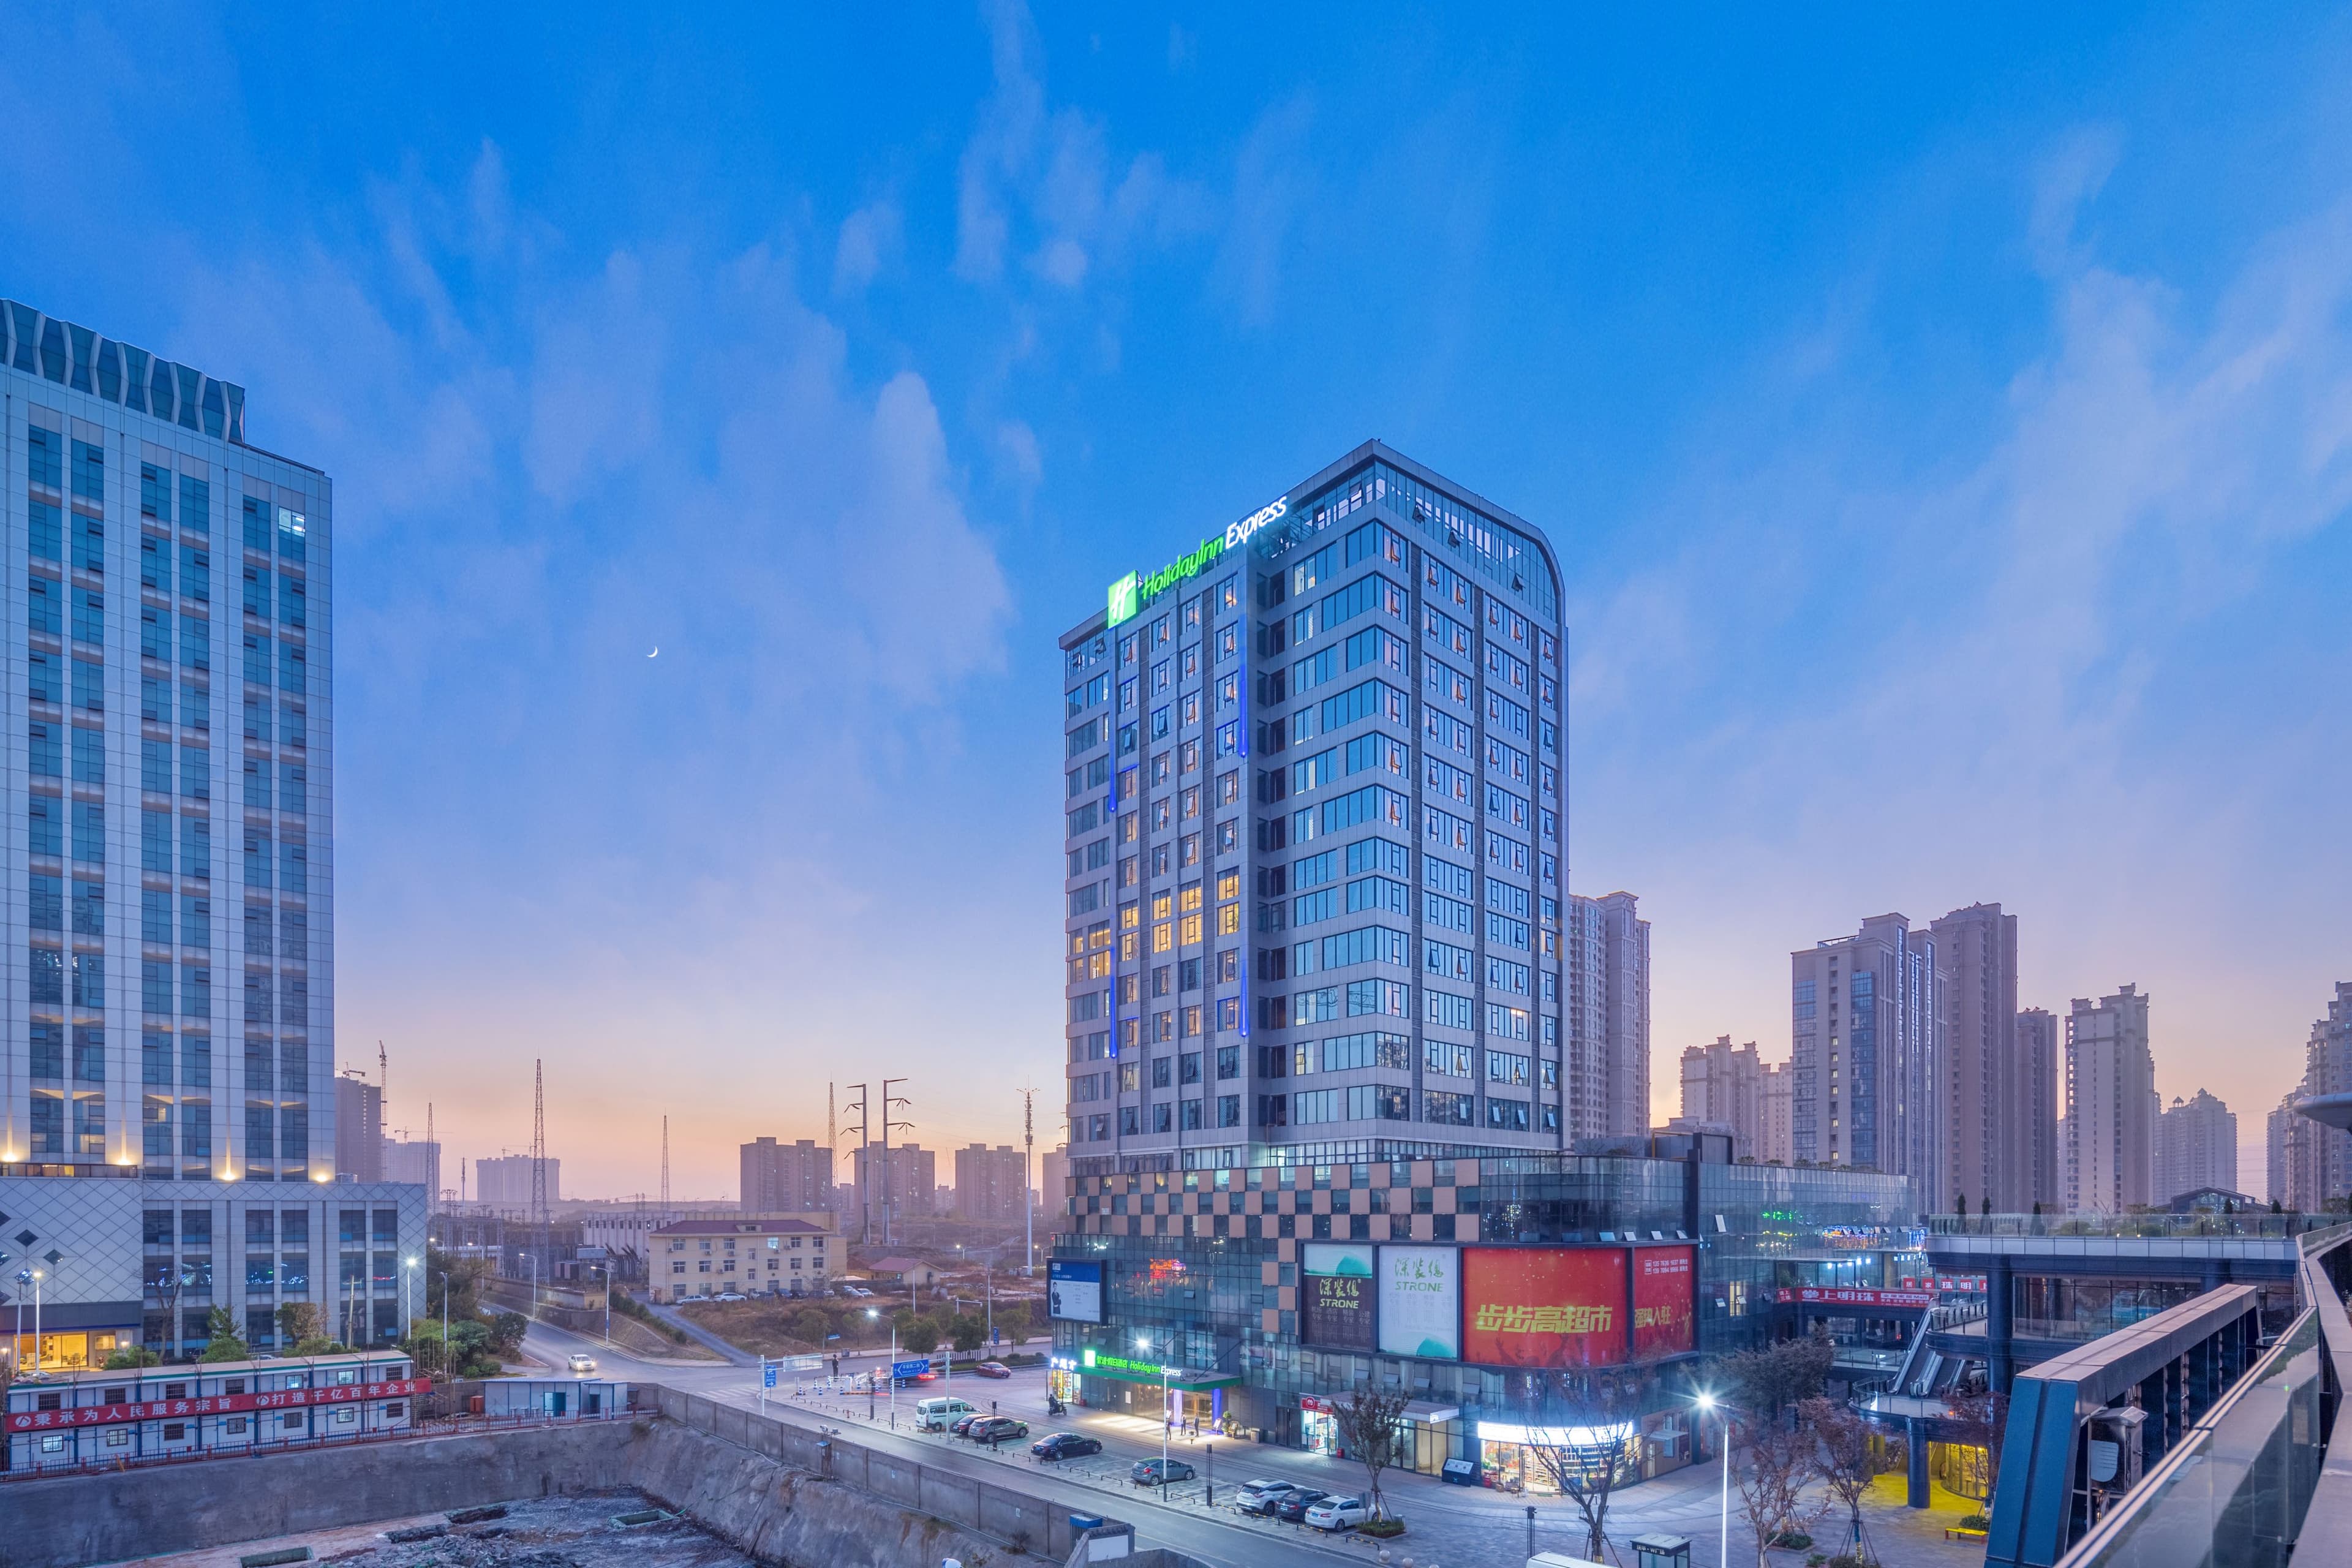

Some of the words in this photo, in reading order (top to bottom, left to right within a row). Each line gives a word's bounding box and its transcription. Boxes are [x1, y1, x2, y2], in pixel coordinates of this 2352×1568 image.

[1226, 496, 1287, 549] Express
[1395, 1281, 1444, 1292] STRONE
[1319, 1298, 1359, 1309] STRONE
[1476, 1303, 1613, 1333] 步步高超市
[271, 1381, 415, 1405] 打造千亿百年企业
[34, 1398, 232, 1427] 秉承为人民服务宗旨
